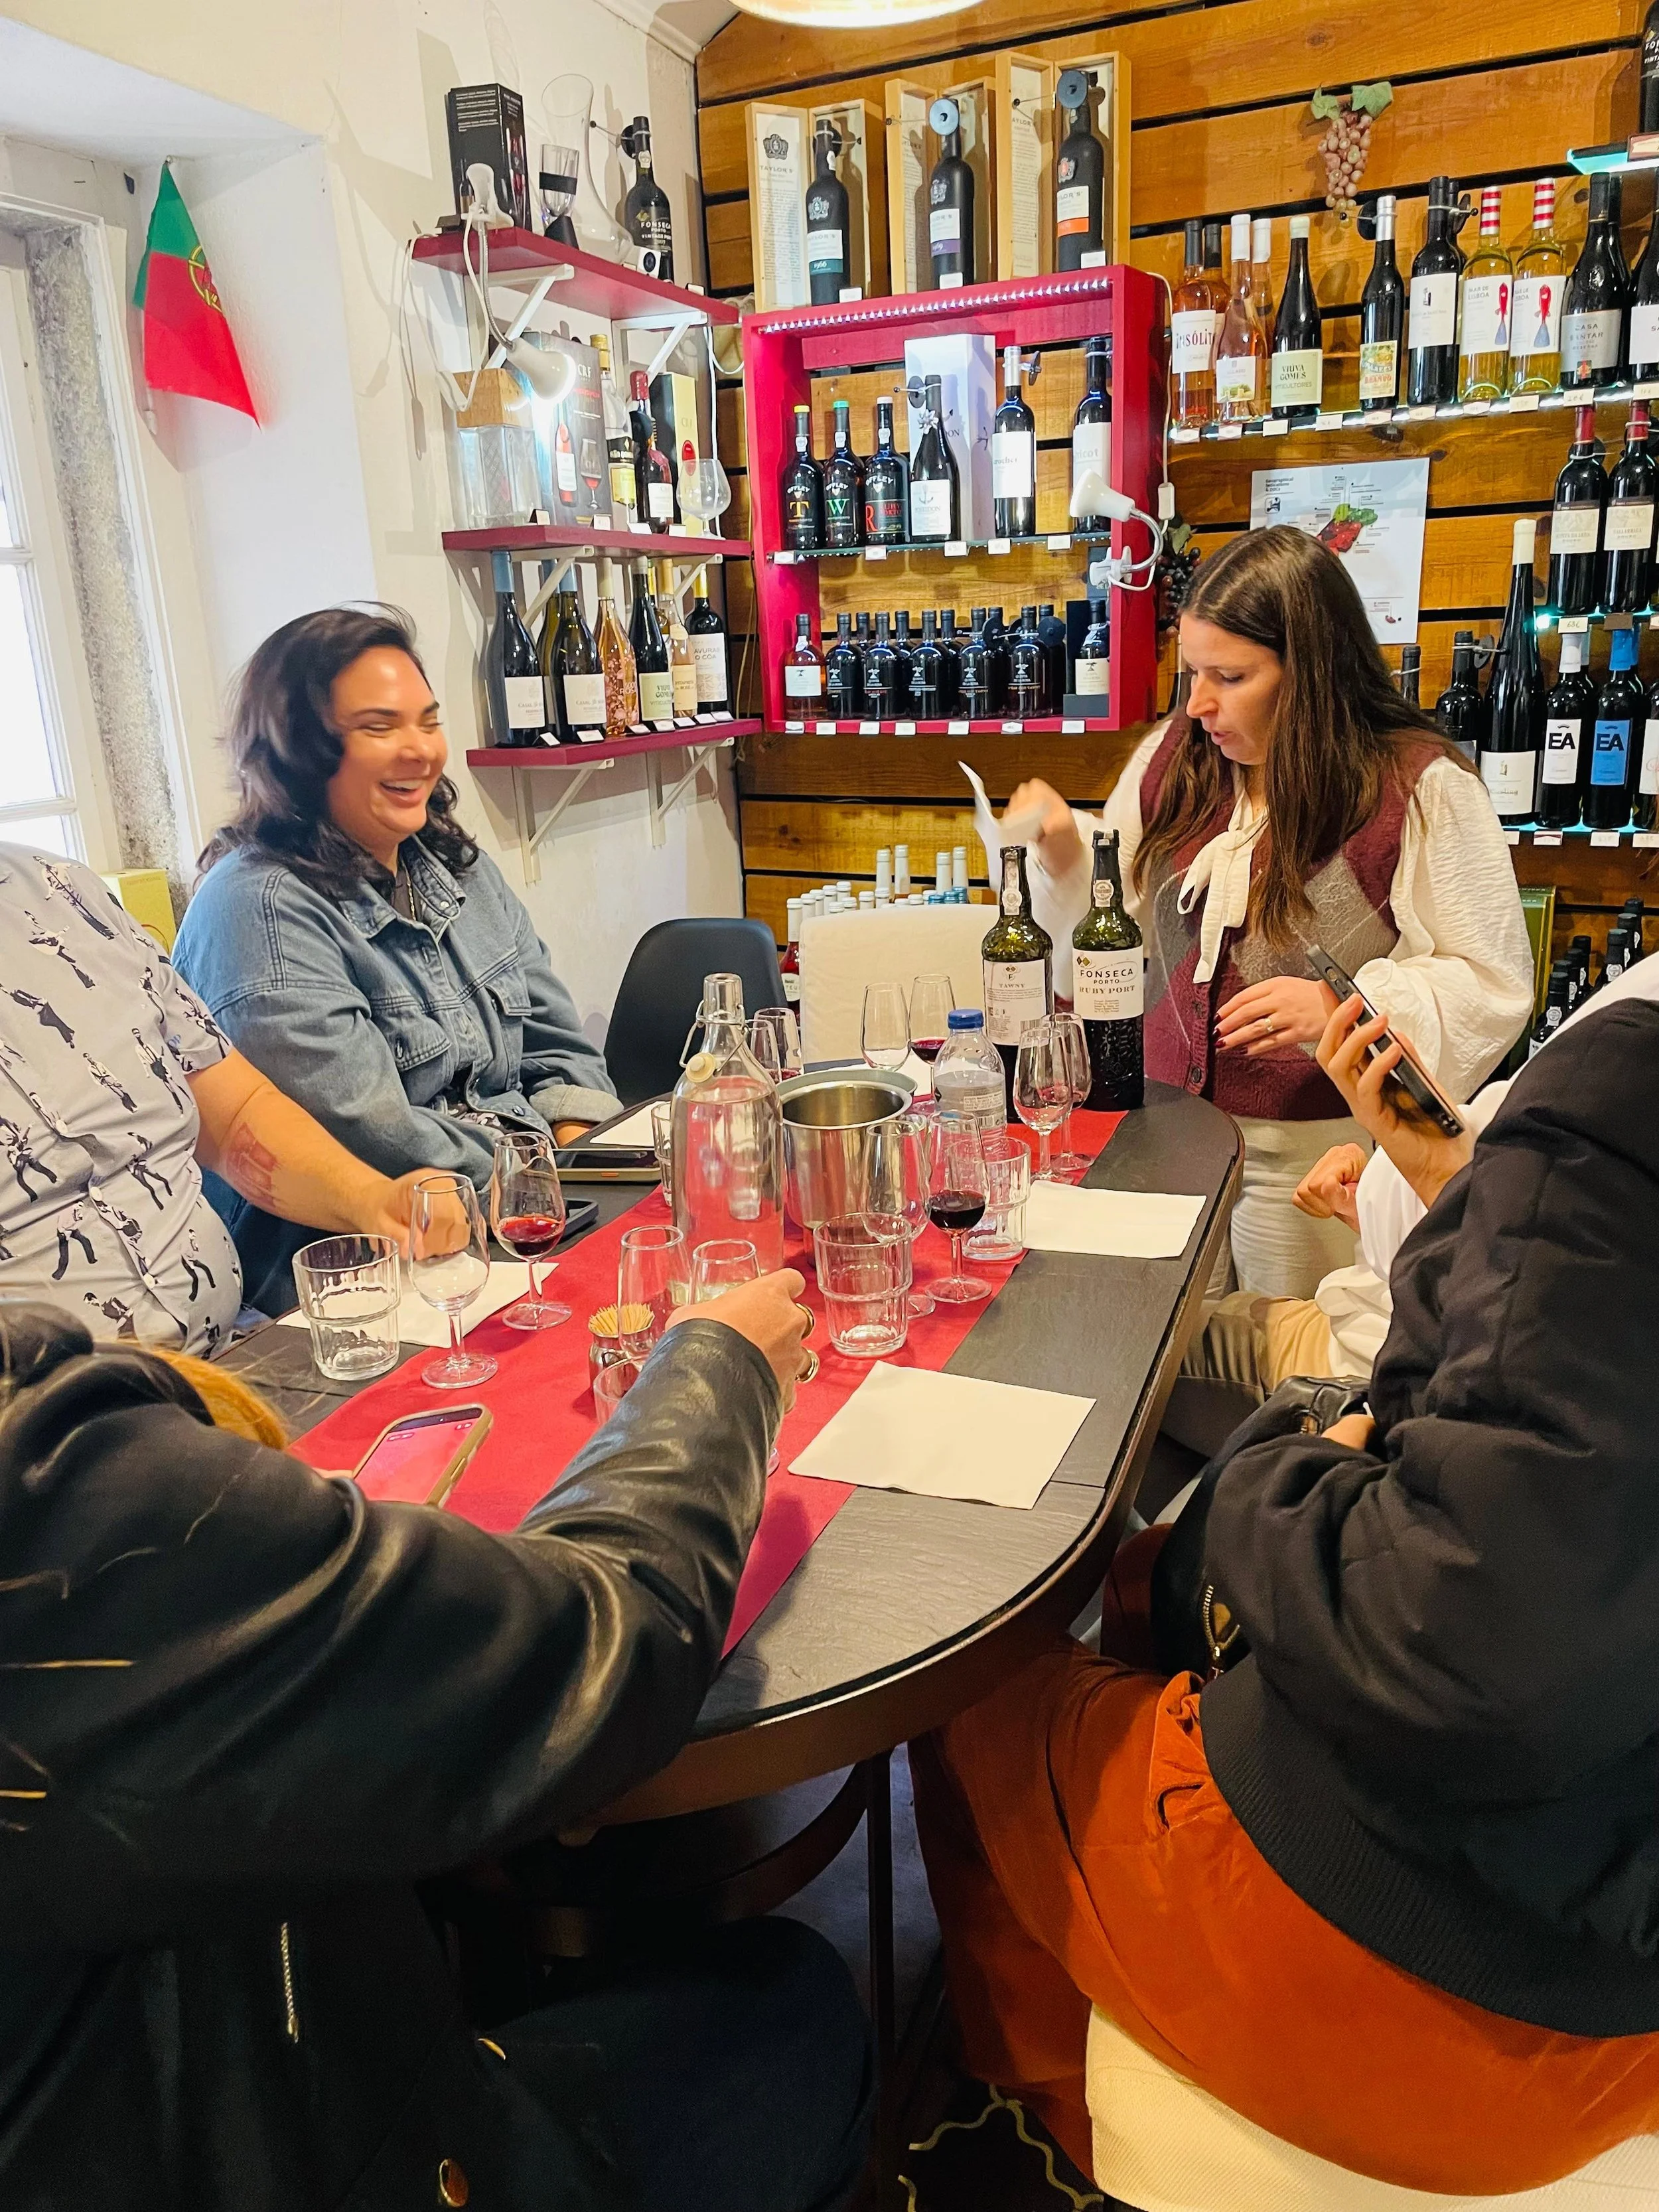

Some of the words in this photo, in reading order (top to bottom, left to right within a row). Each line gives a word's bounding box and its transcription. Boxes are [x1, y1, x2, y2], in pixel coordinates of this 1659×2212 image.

[866, 475, 893, 486] OFFLEY
[790, 501, 809, 517] T
[826, 498, 849, 514] W
[1548, 733, 1575, 749] EA
[1596, 733, 1624, 751] EA
[1080, 968, 1133, 978] FONSECA
[1109, 985, 1135, 994] PORT
